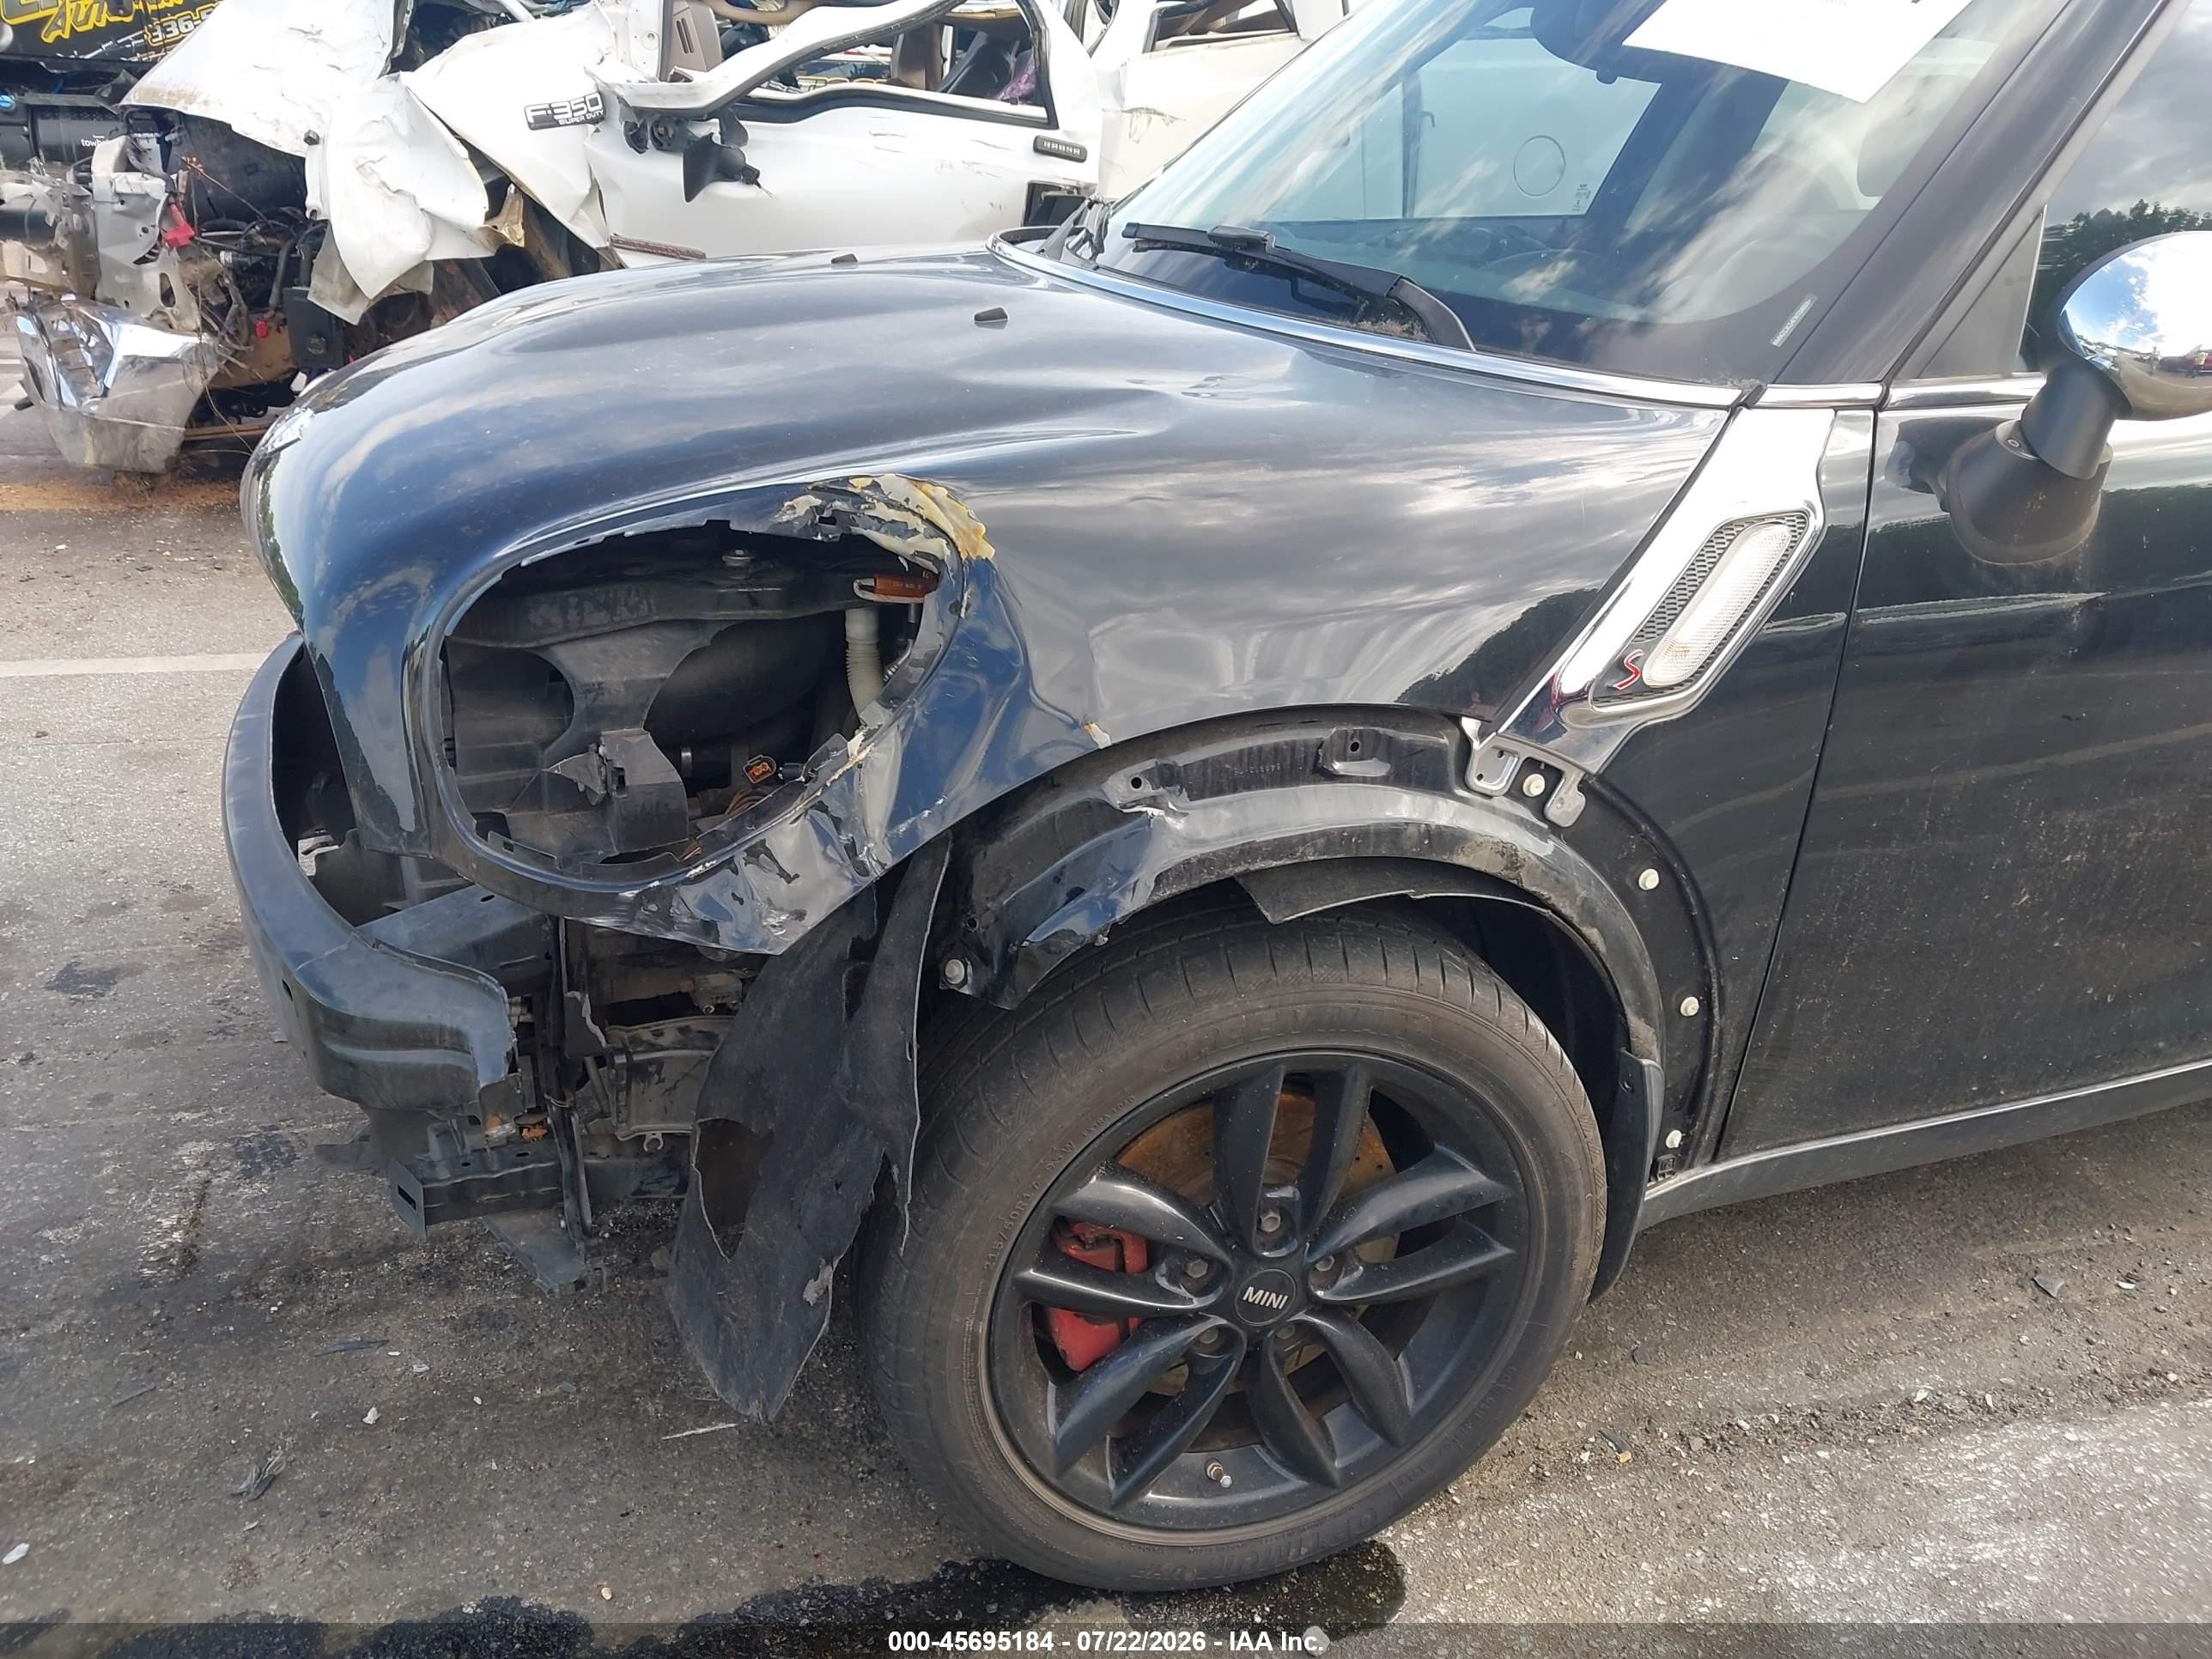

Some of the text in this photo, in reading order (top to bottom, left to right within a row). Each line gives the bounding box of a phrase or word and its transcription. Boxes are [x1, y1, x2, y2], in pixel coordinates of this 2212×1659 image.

[558, 110, 604, 125] SUPER DUTY
[1613, 648, 1644, 690] S
[1243, 1286, 1289, 1310] MINI
